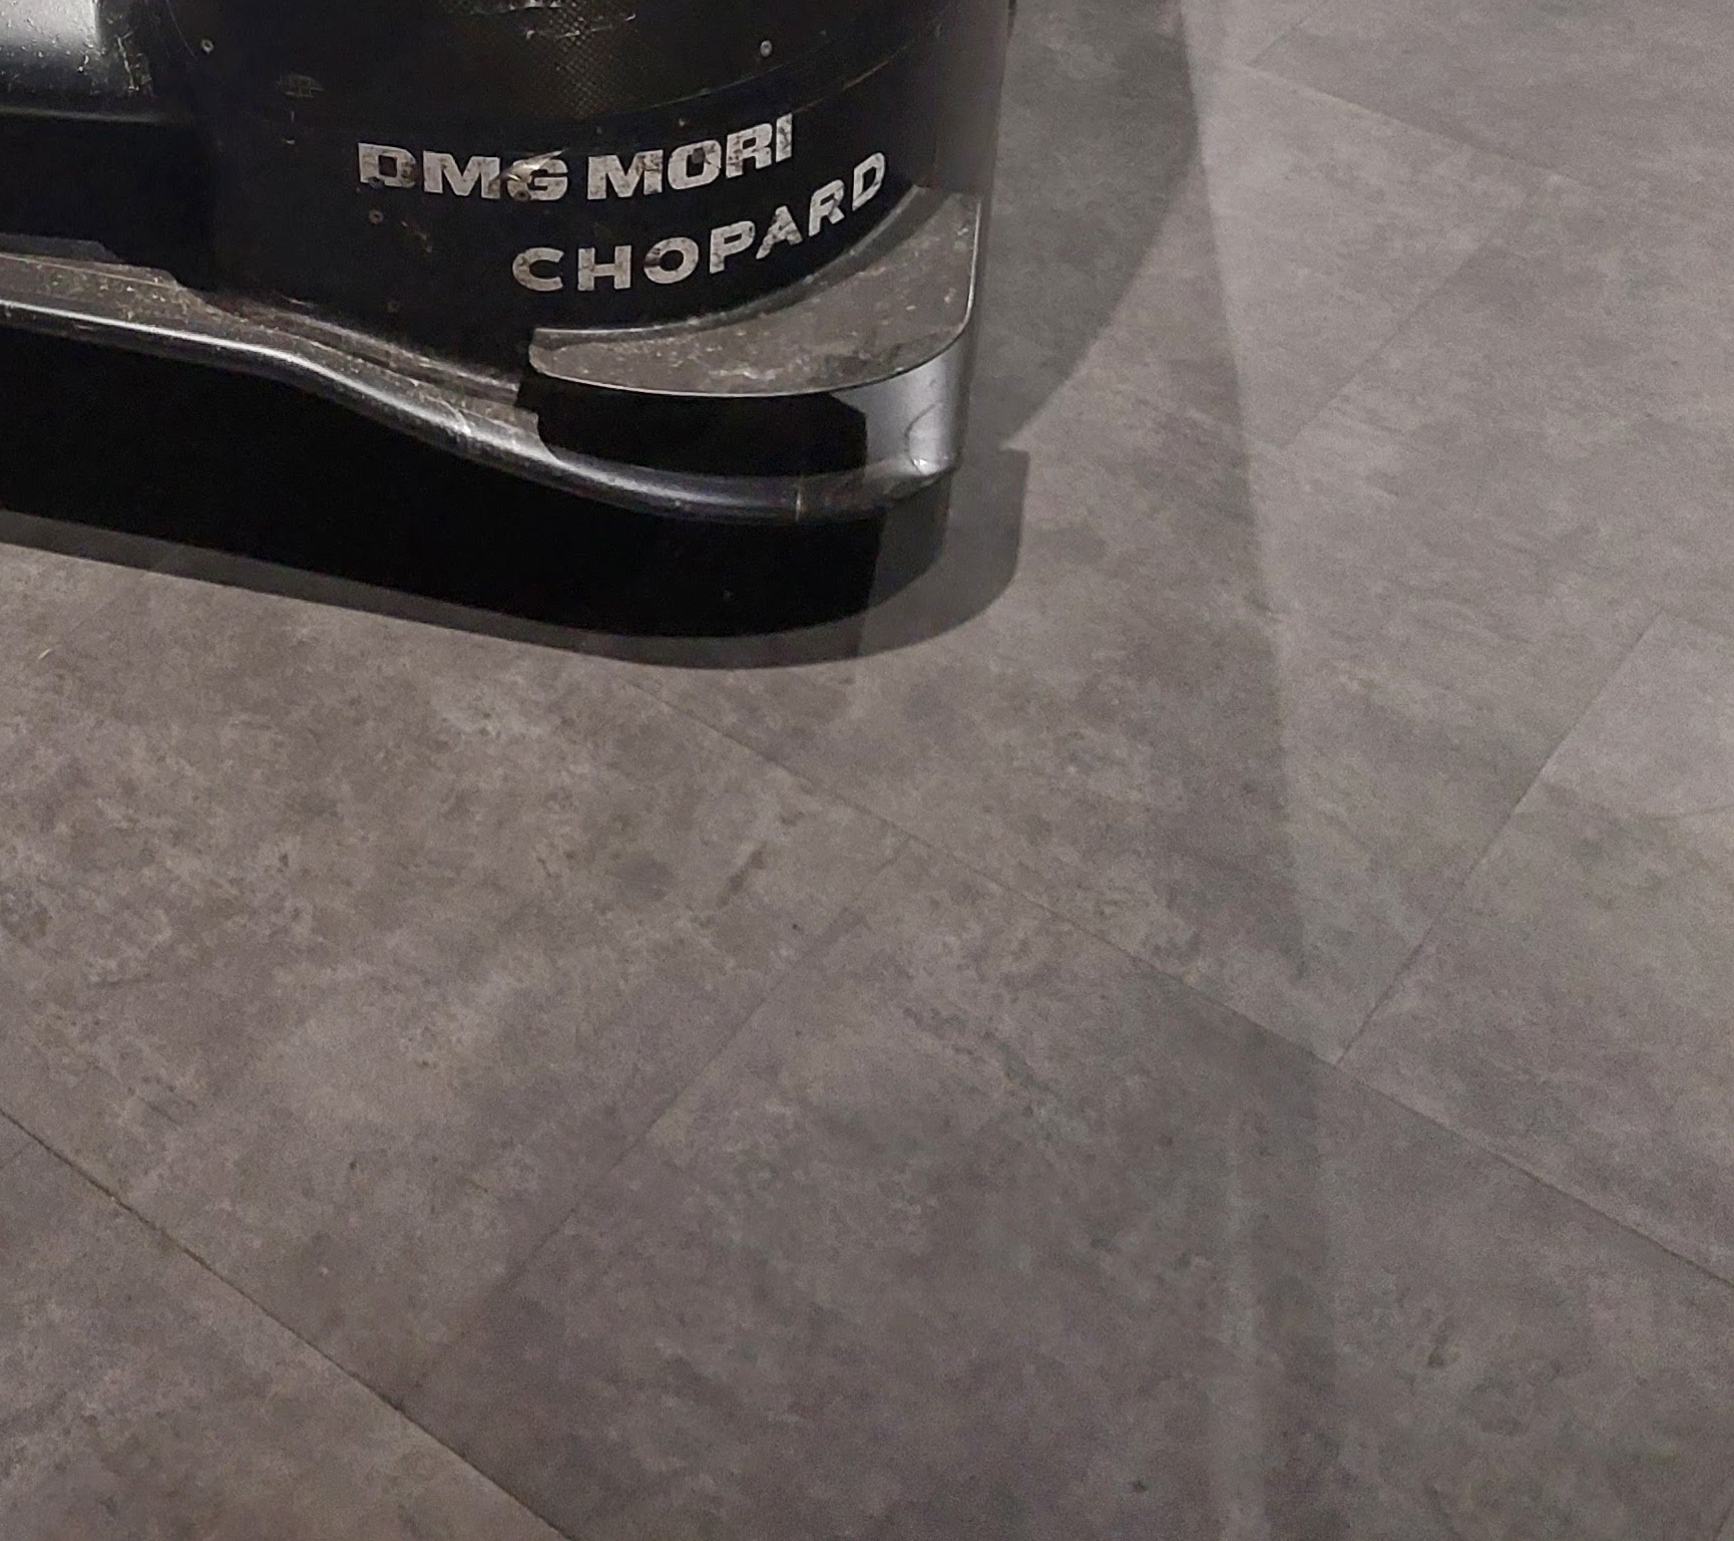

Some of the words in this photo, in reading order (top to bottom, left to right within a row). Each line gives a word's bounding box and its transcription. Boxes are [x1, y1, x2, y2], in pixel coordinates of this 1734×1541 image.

[357, 142, 567, 203] DMG
[587, 113, 794, 201] MORI
[512, 149, 888, 293] CHOPARD
